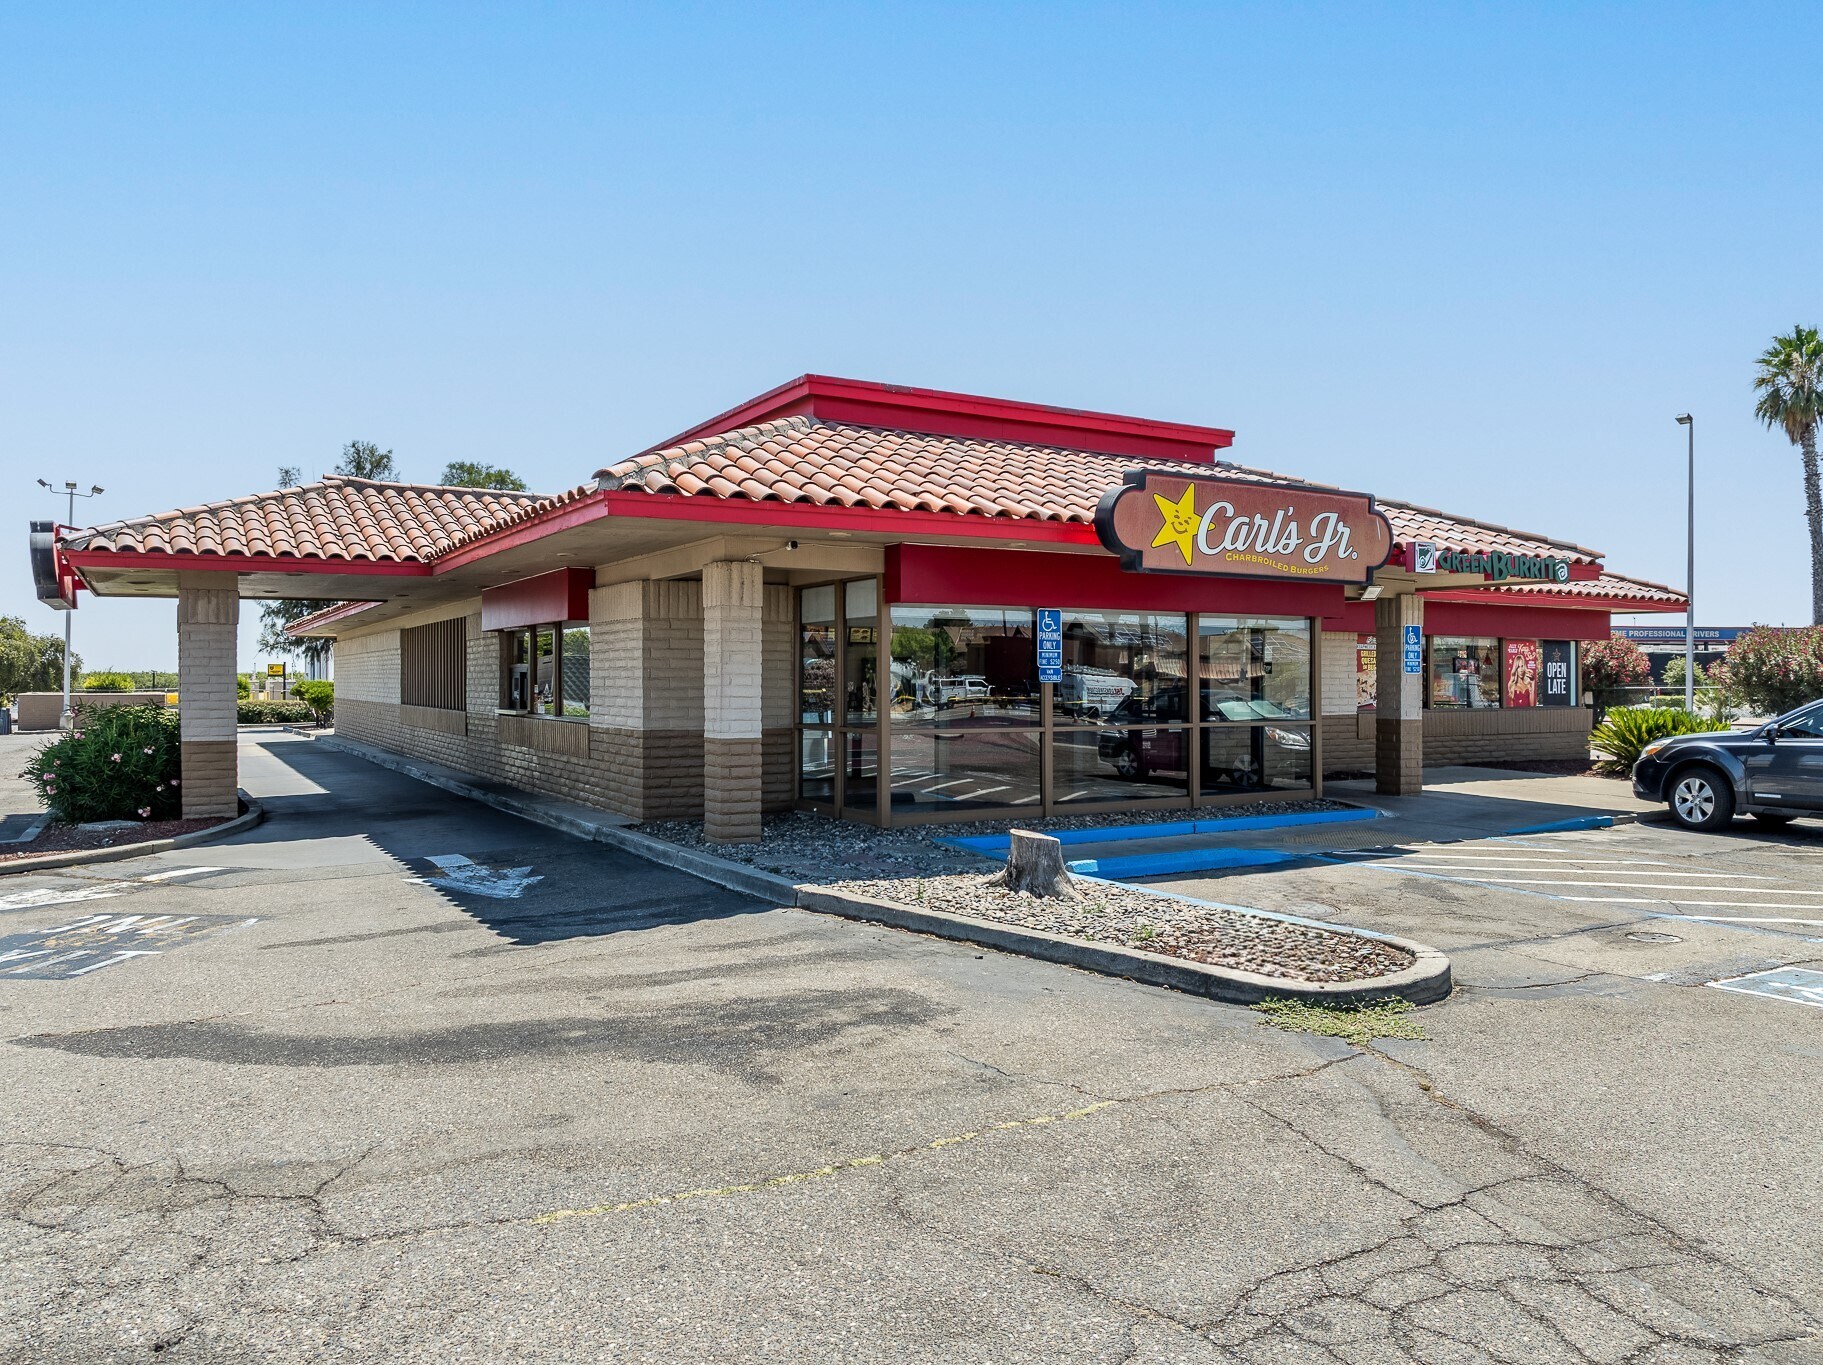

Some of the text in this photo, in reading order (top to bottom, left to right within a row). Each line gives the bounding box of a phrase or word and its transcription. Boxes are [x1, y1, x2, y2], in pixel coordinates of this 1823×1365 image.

[1197, 501, 1359, 564] Carl's Jr.
[1225, 552, 1329, 575] CHARBROILED BURGERS
[1040, 631, 1060, 641] PARKING
[1628, 630, 1686, 638] PROFESSIONAL
[1692, 630, 1720, 638] RIVERS
[1042, 641, 1057, 650] ONLY
[1408, 651, 1418, 659] ONLY
[1547, 662, 1567, 678] OPEN
[1547, 678, 1567, 694] LATE
